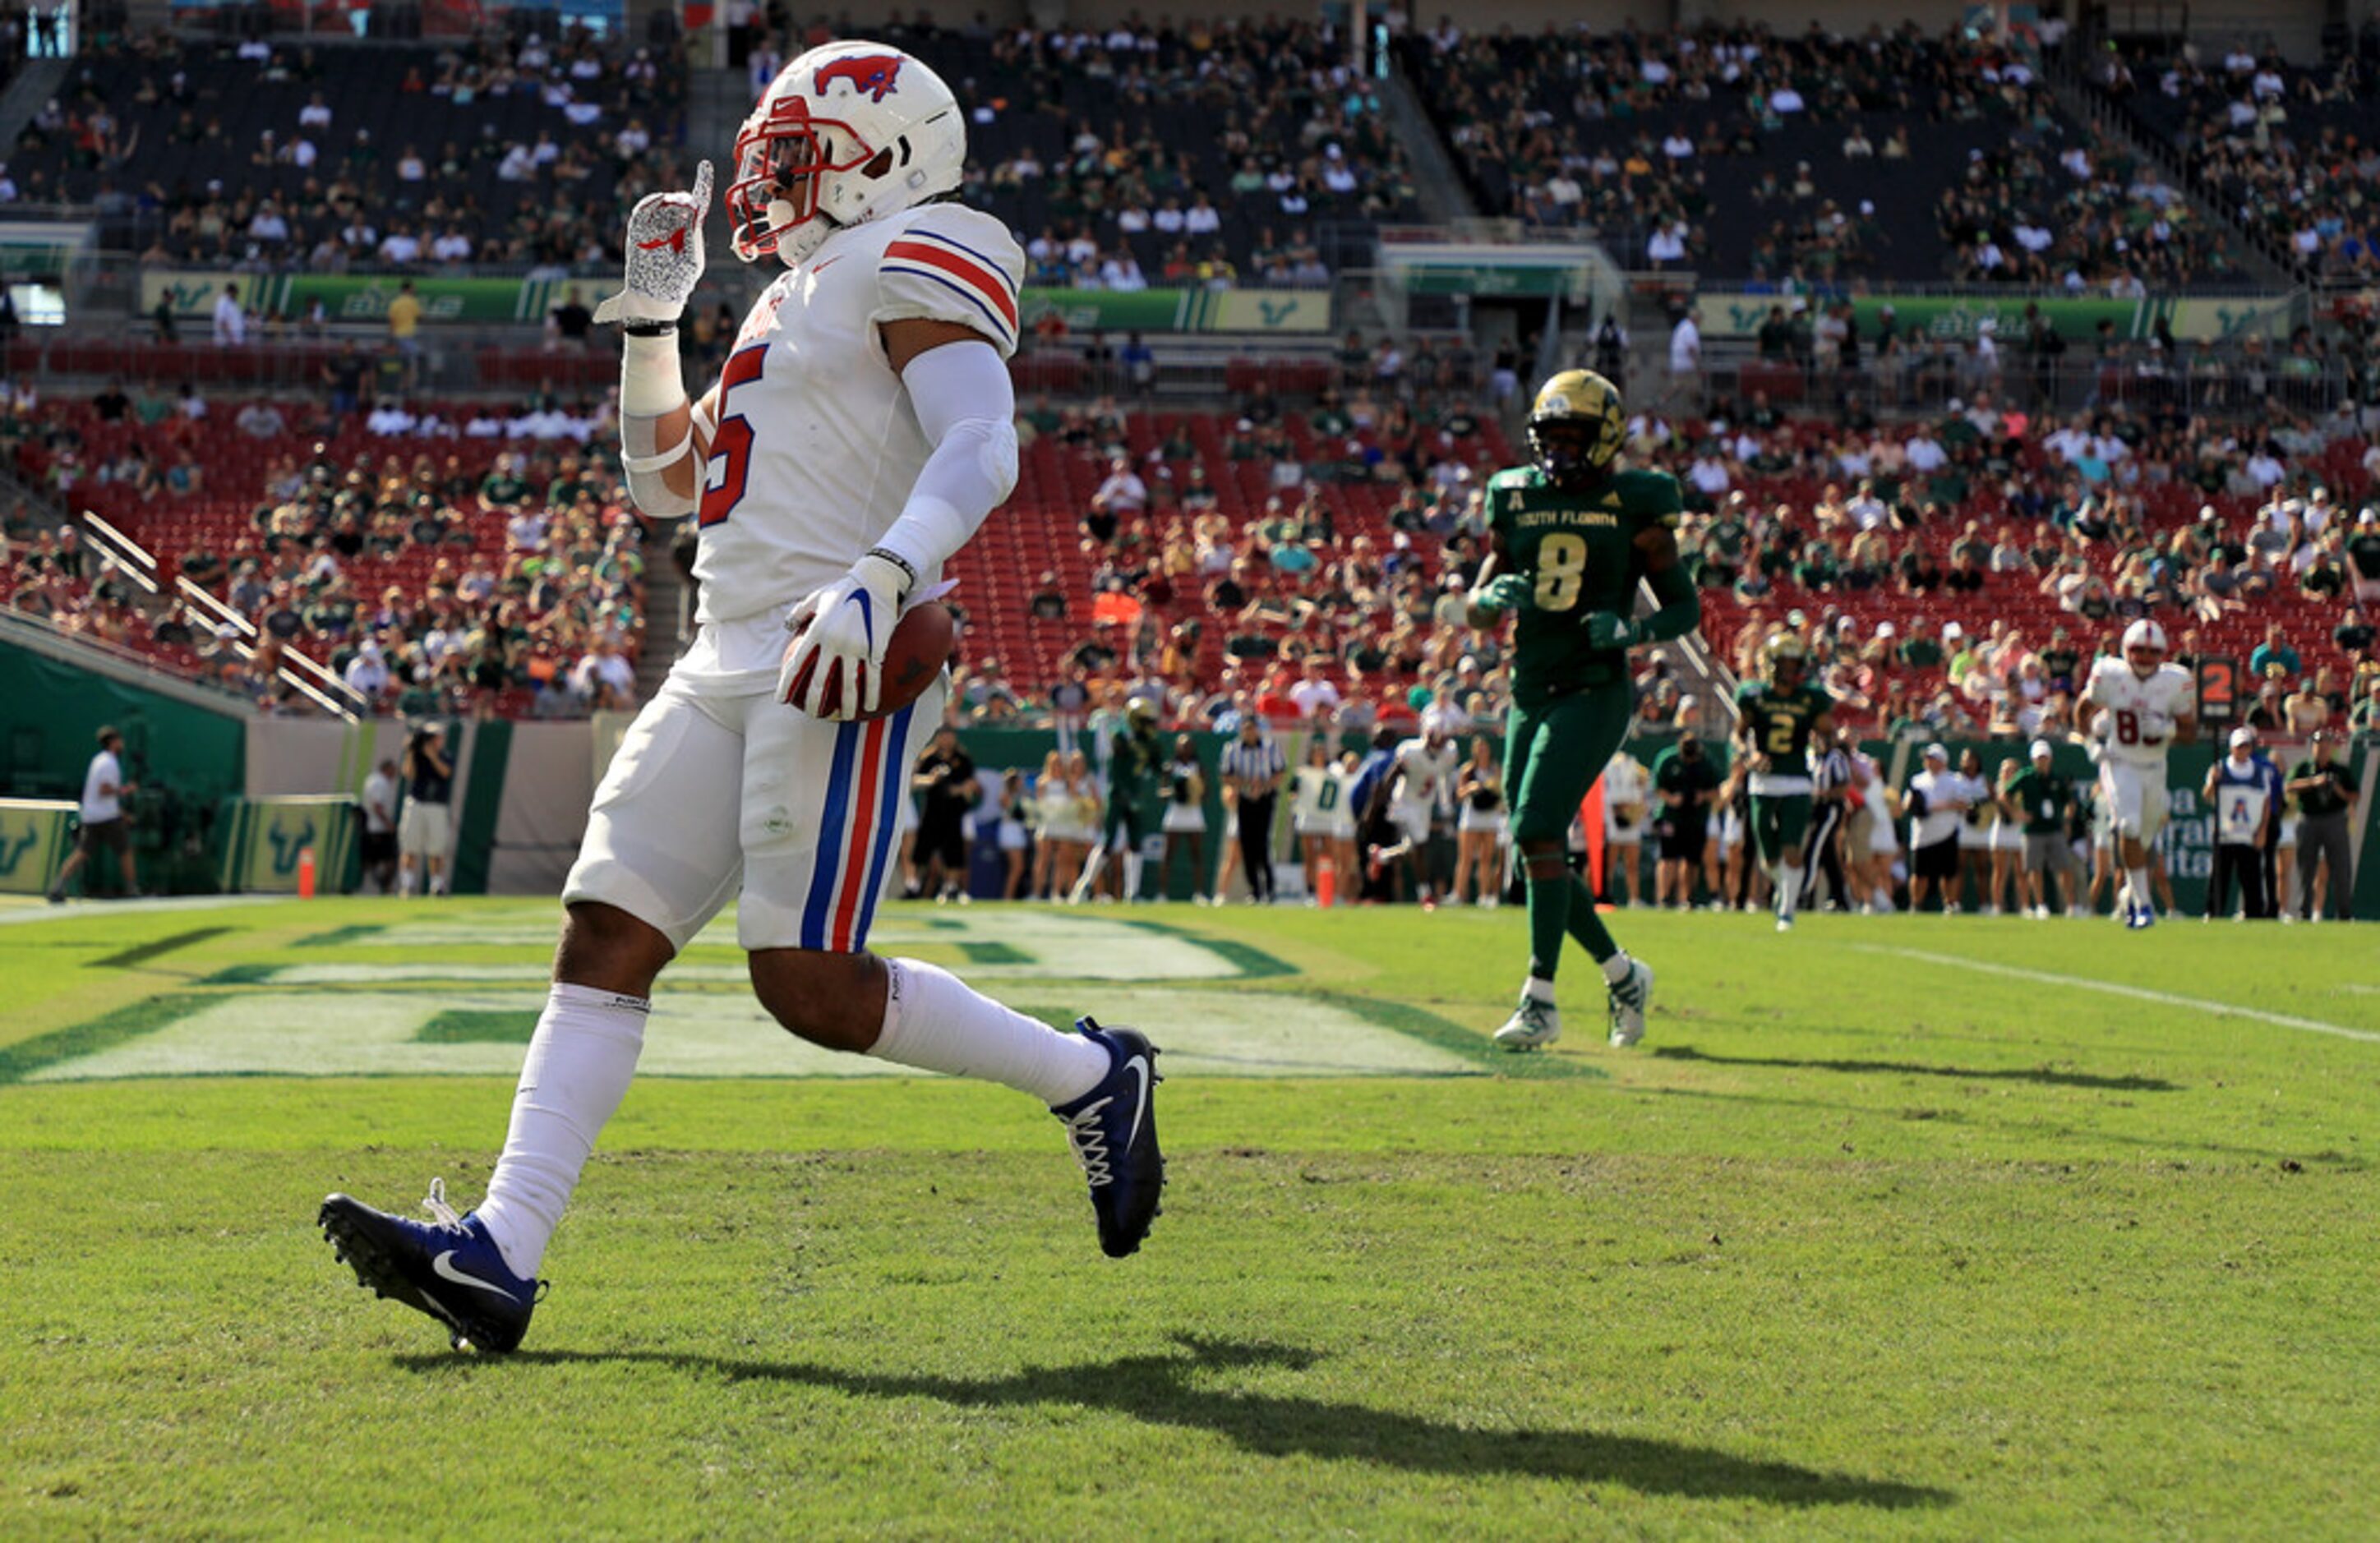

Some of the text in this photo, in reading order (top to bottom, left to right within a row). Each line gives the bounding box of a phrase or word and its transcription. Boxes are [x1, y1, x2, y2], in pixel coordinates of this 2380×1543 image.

[699, 343, 771, 529] 5
[1515, 510, 1618, 527] SOUTH FLORIDA
[1534, 532, 1587, 611] 8
[2202, 663, 2232, 702] 2
[1768, 713, 1795, 753] 2
